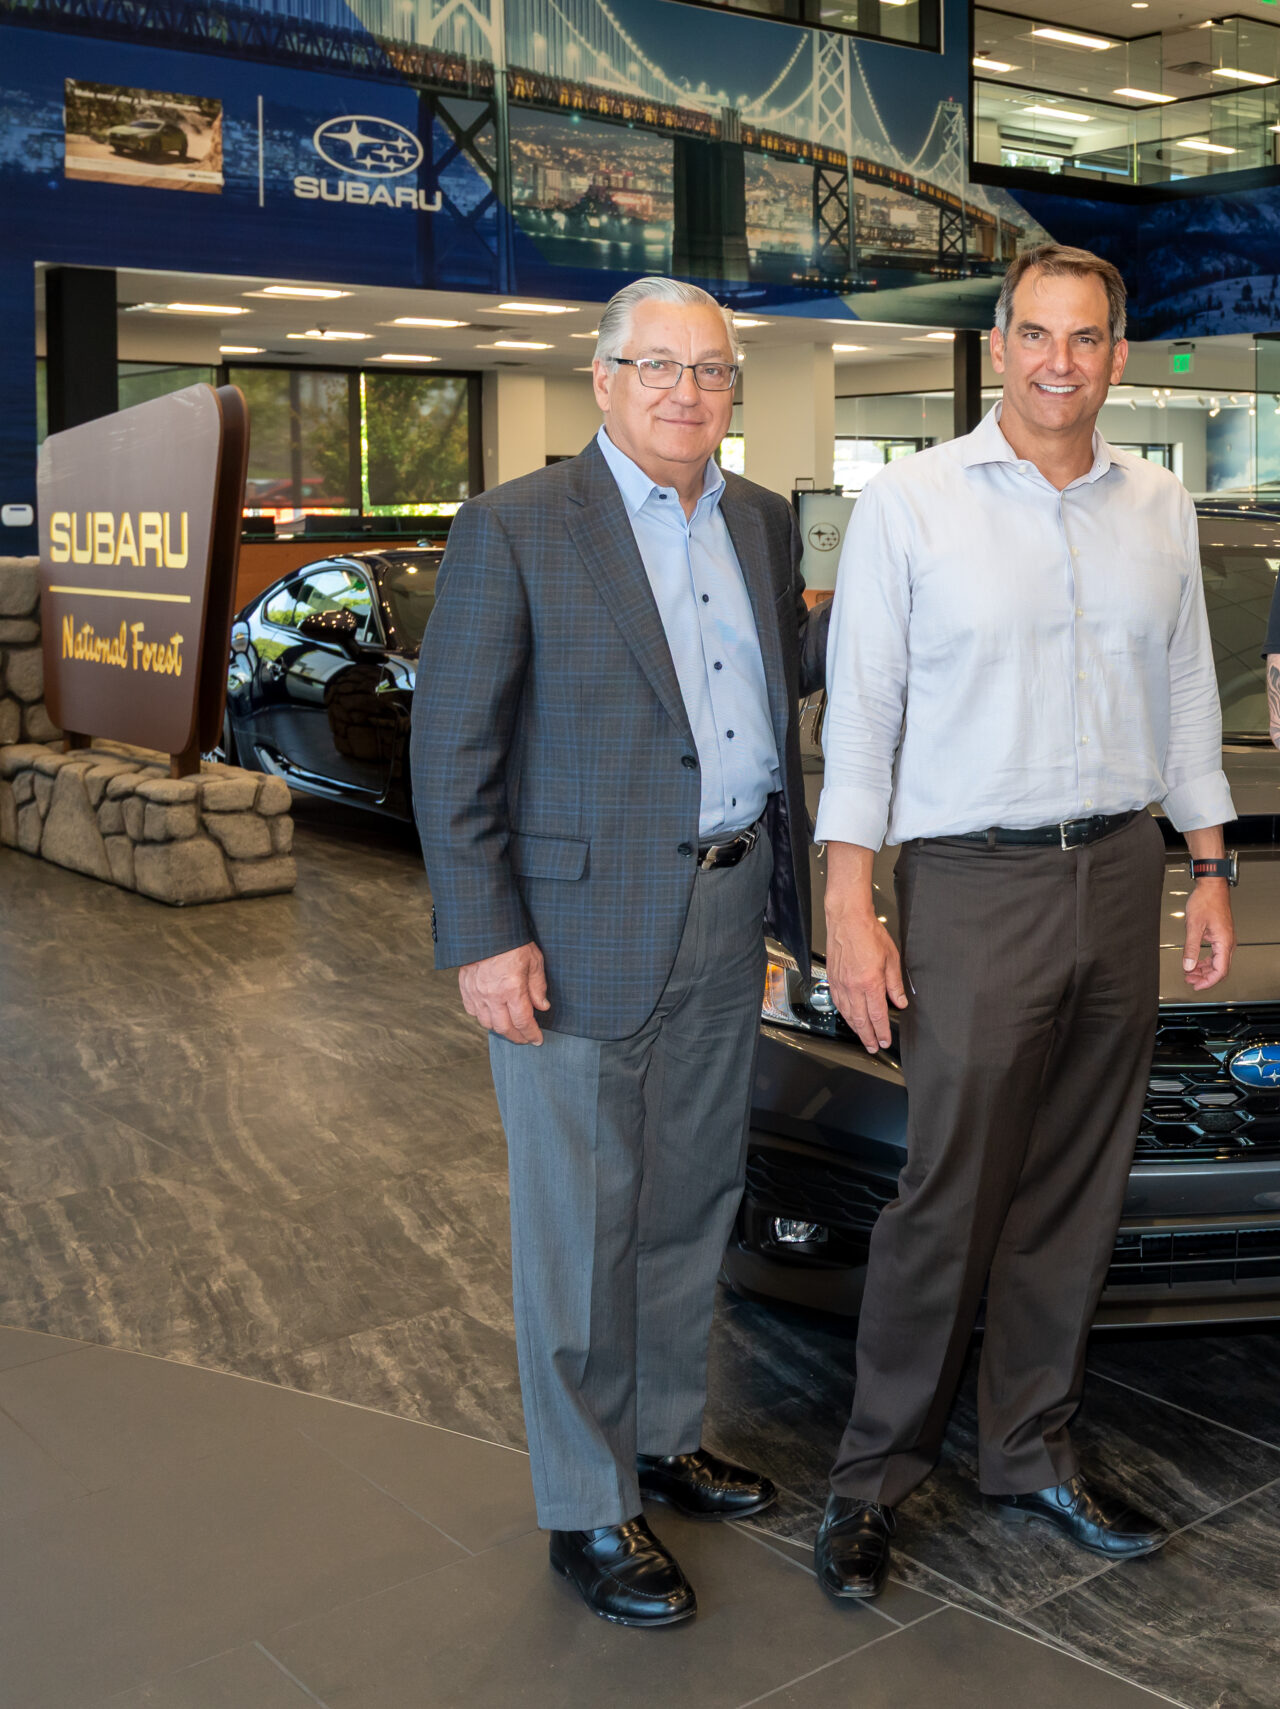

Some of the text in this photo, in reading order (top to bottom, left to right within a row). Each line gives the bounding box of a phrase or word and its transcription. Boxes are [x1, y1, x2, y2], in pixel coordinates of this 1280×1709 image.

[294, 176, 442, 211] SUBARU
[51, 512, 188, 568] SUBARU
[62, 614, 184, 677] National Forest
